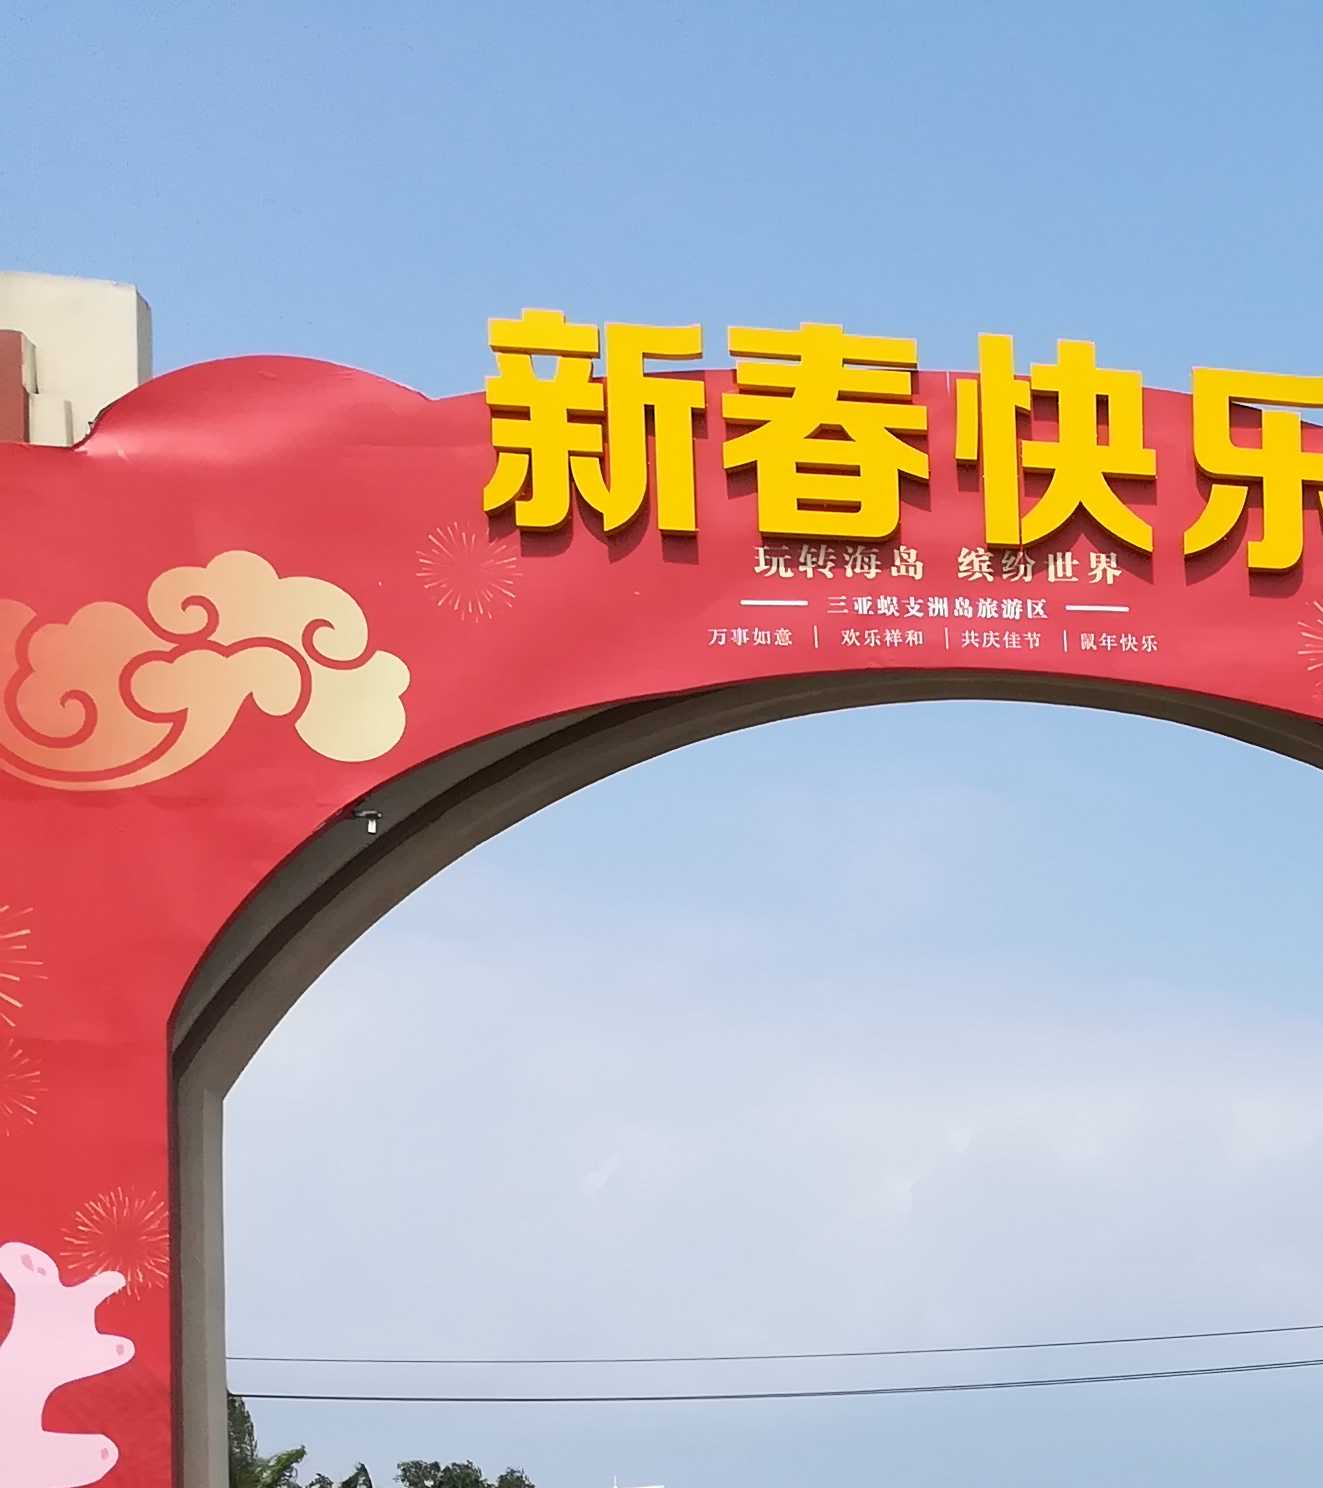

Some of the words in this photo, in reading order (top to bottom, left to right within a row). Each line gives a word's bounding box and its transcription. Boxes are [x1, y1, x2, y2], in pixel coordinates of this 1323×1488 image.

[753, 545, 925, 580] 玩转海岛
[956, 546, 1124, 585] 缤纷世界
[827, 595, 1049, 620] 三亚蜈支洲岛旅游区
[707, 627, 793, 646] 万事如意
[841, 629, 925, 648] 欢乐祥和
[961, 629, 1042, 650] 共庆佳节
[1079, 632, 1159, 653] 鼠年快乐
